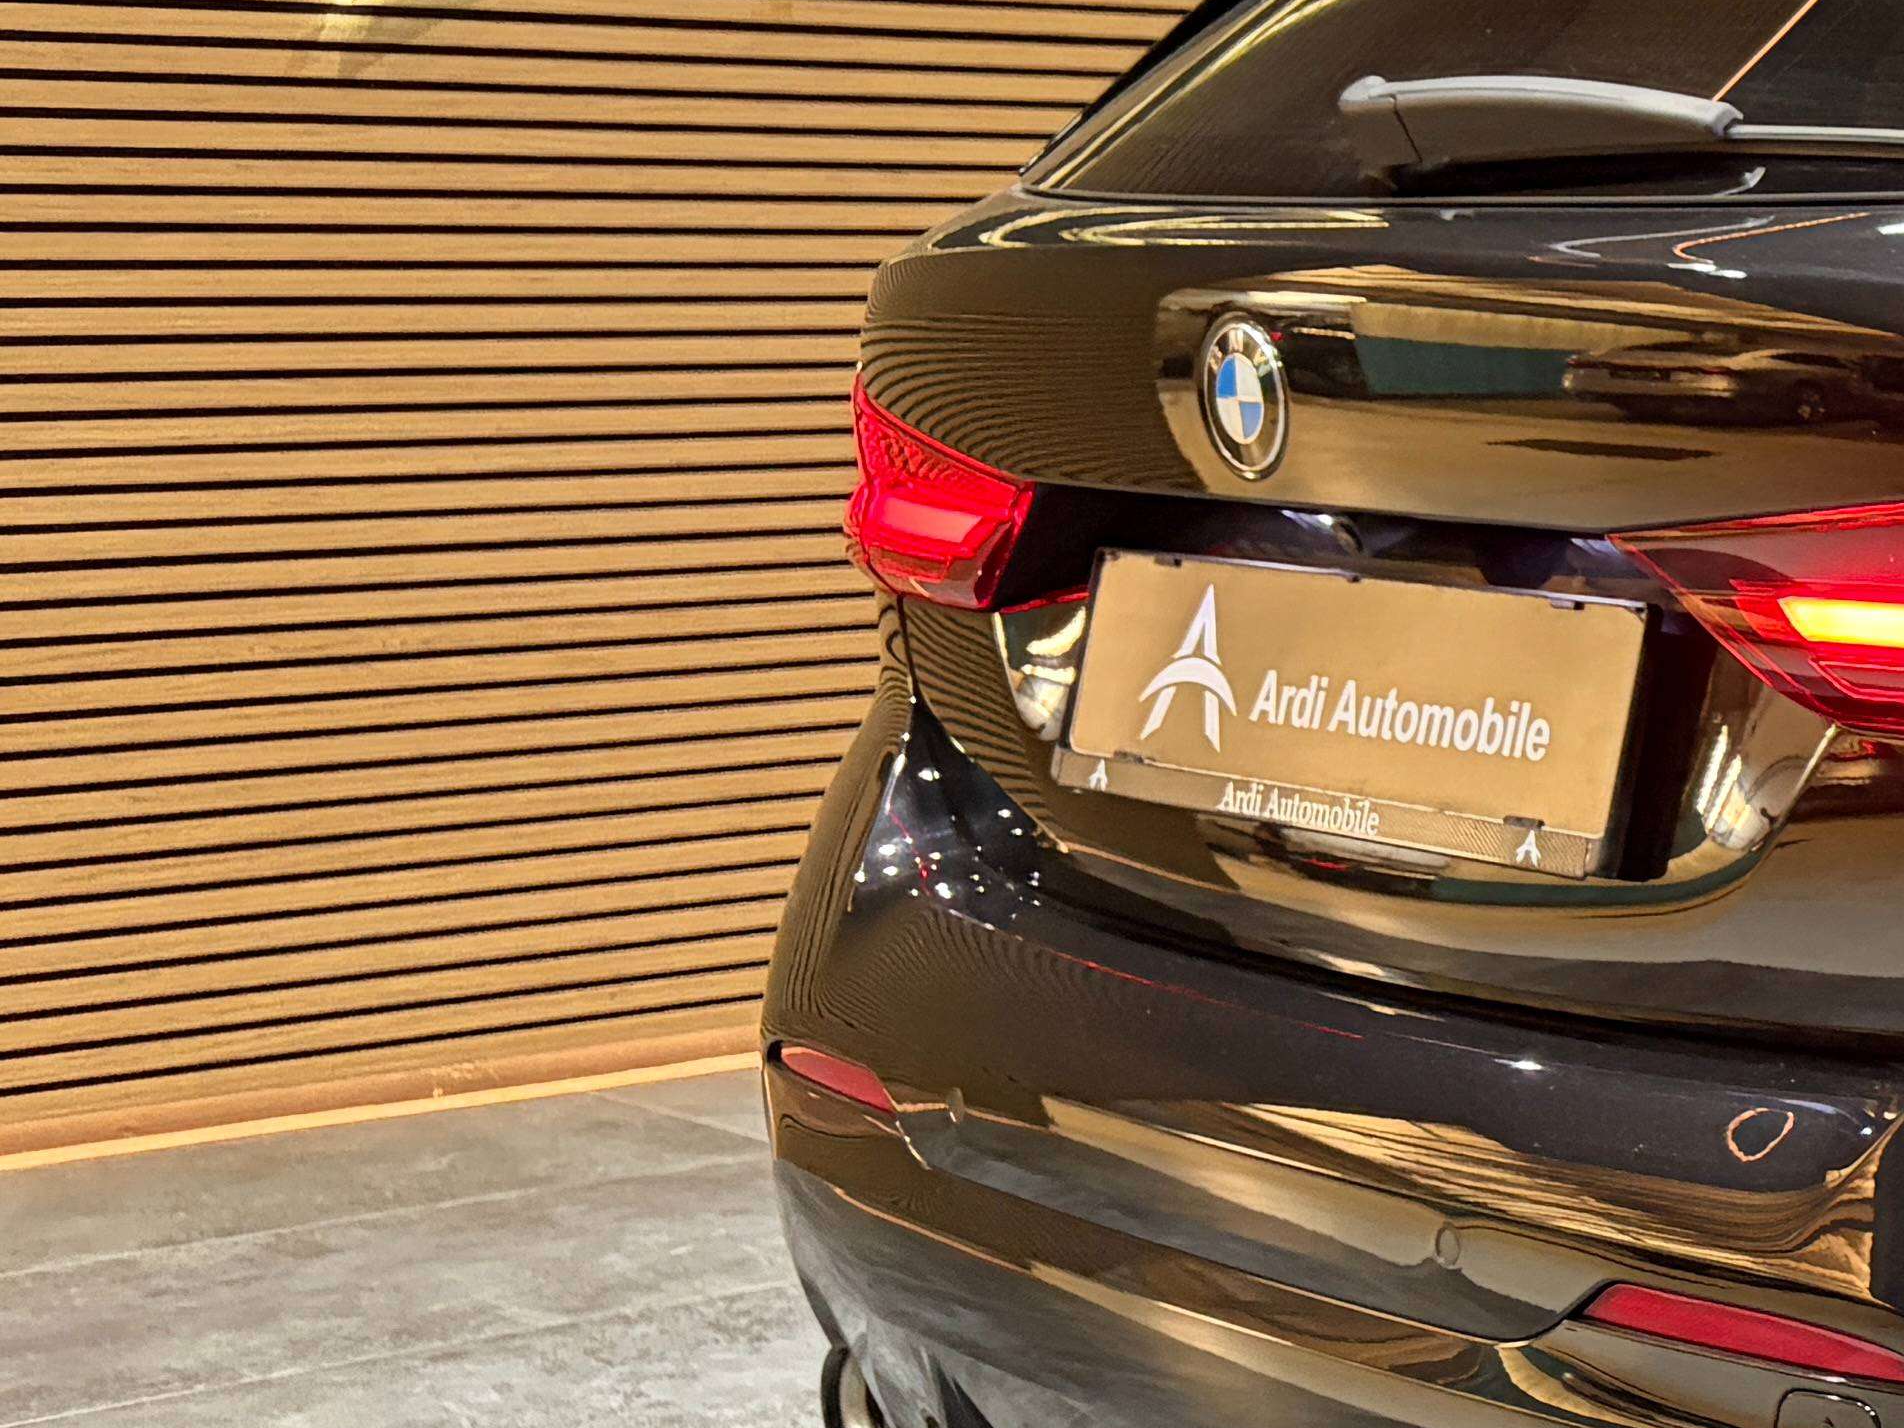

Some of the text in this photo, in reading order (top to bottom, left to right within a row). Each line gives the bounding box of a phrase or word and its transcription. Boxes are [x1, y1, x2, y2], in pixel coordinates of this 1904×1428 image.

[1249, 669, 1550, 761] Ardi Automobile
[1216, 781, 1380, 836] Ardi Automobile
